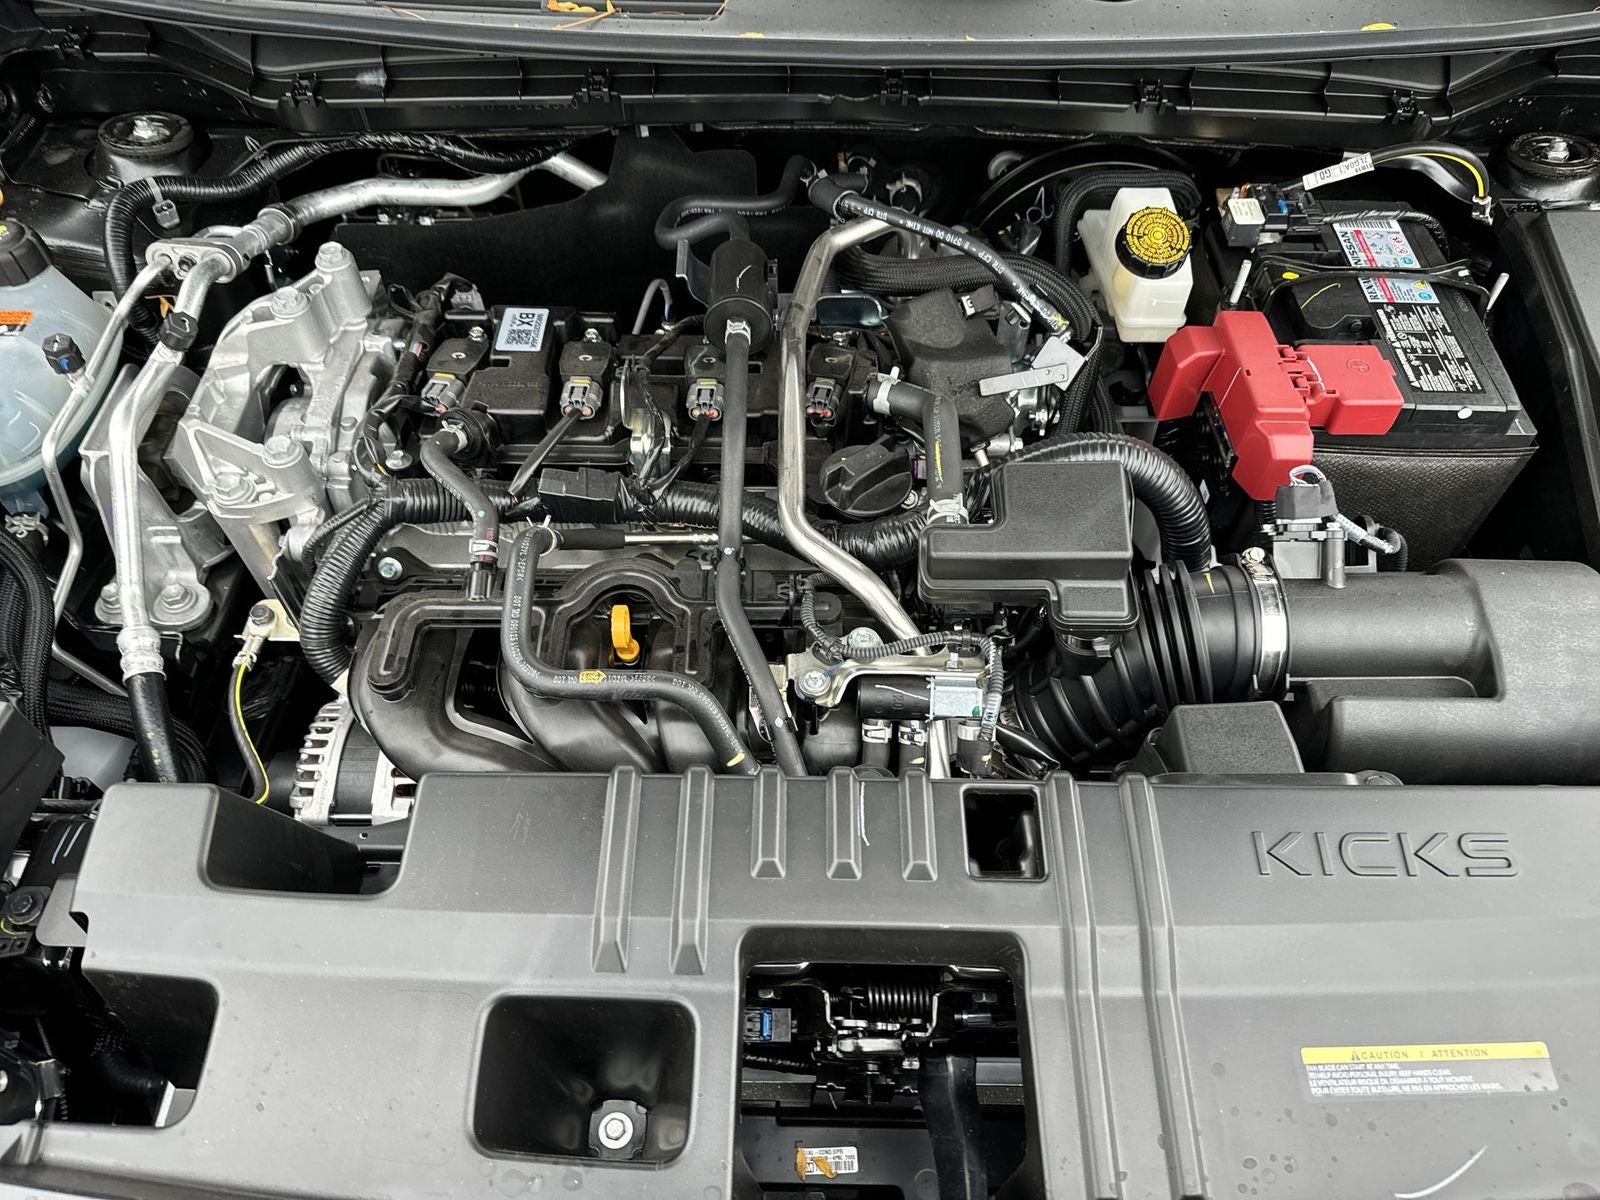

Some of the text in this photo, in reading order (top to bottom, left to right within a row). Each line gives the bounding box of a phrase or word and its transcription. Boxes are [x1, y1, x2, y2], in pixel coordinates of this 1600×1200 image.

[1340, 231, 1362, 266] NISSAN
[517, 312, 535, 326] BX
[1252, 831, 1519, 877] KICKS
[1362, 1051, 1408, 1060] CAUTION
[1432, 1049, 1489, 1058] ATTENTION
